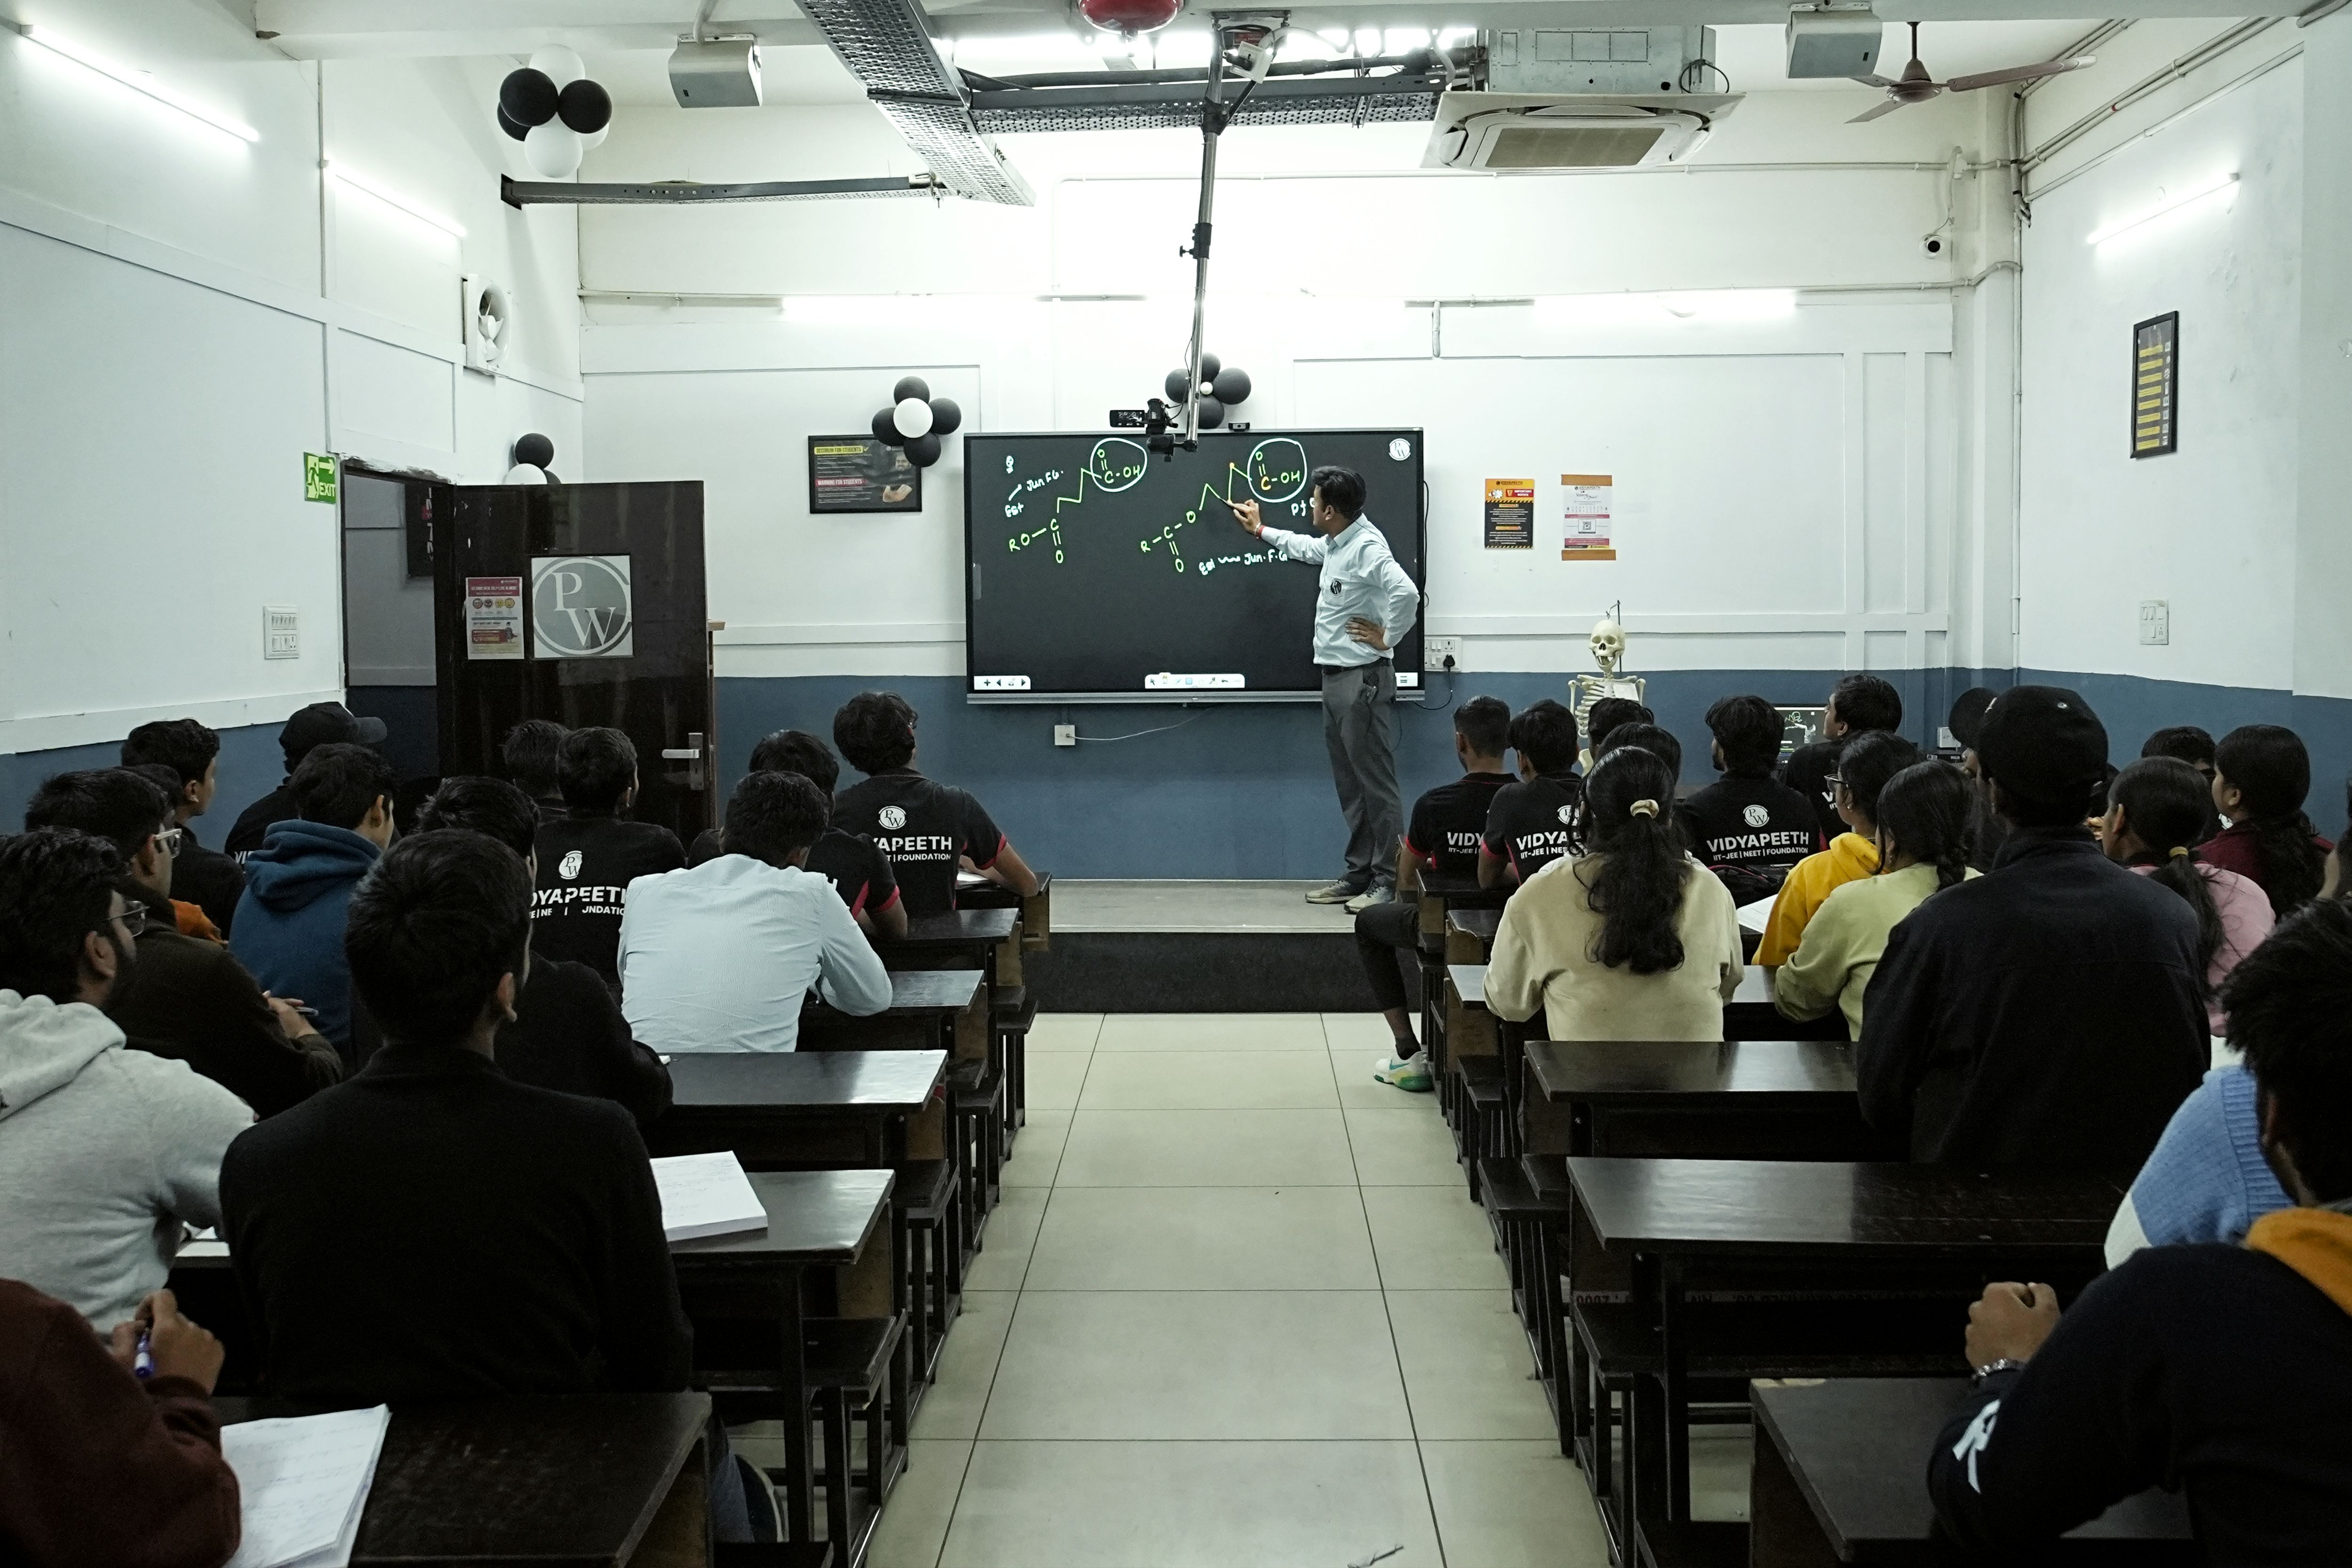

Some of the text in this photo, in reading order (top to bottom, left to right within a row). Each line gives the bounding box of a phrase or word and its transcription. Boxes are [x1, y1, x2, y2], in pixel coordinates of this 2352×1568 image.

[319, 482, 335, 497] EXIT
[1749, 808, 1764, 824] PW
[873, 836, 952, 851] APEETH
[1447, 831, 1484, 846] VIDY
[1516, 831, 1568, 851] VIDYA
[1707, 831, 1809, 852] VIDYAPEETH
[898, 853, 952, 861] FOUNDATION
[1520, 848, 1544, 860] IIT-JEE
[1713, 852, 1739, 861] IIT-JEE
[1766, 847, 1808, 856] FOUNDATION
